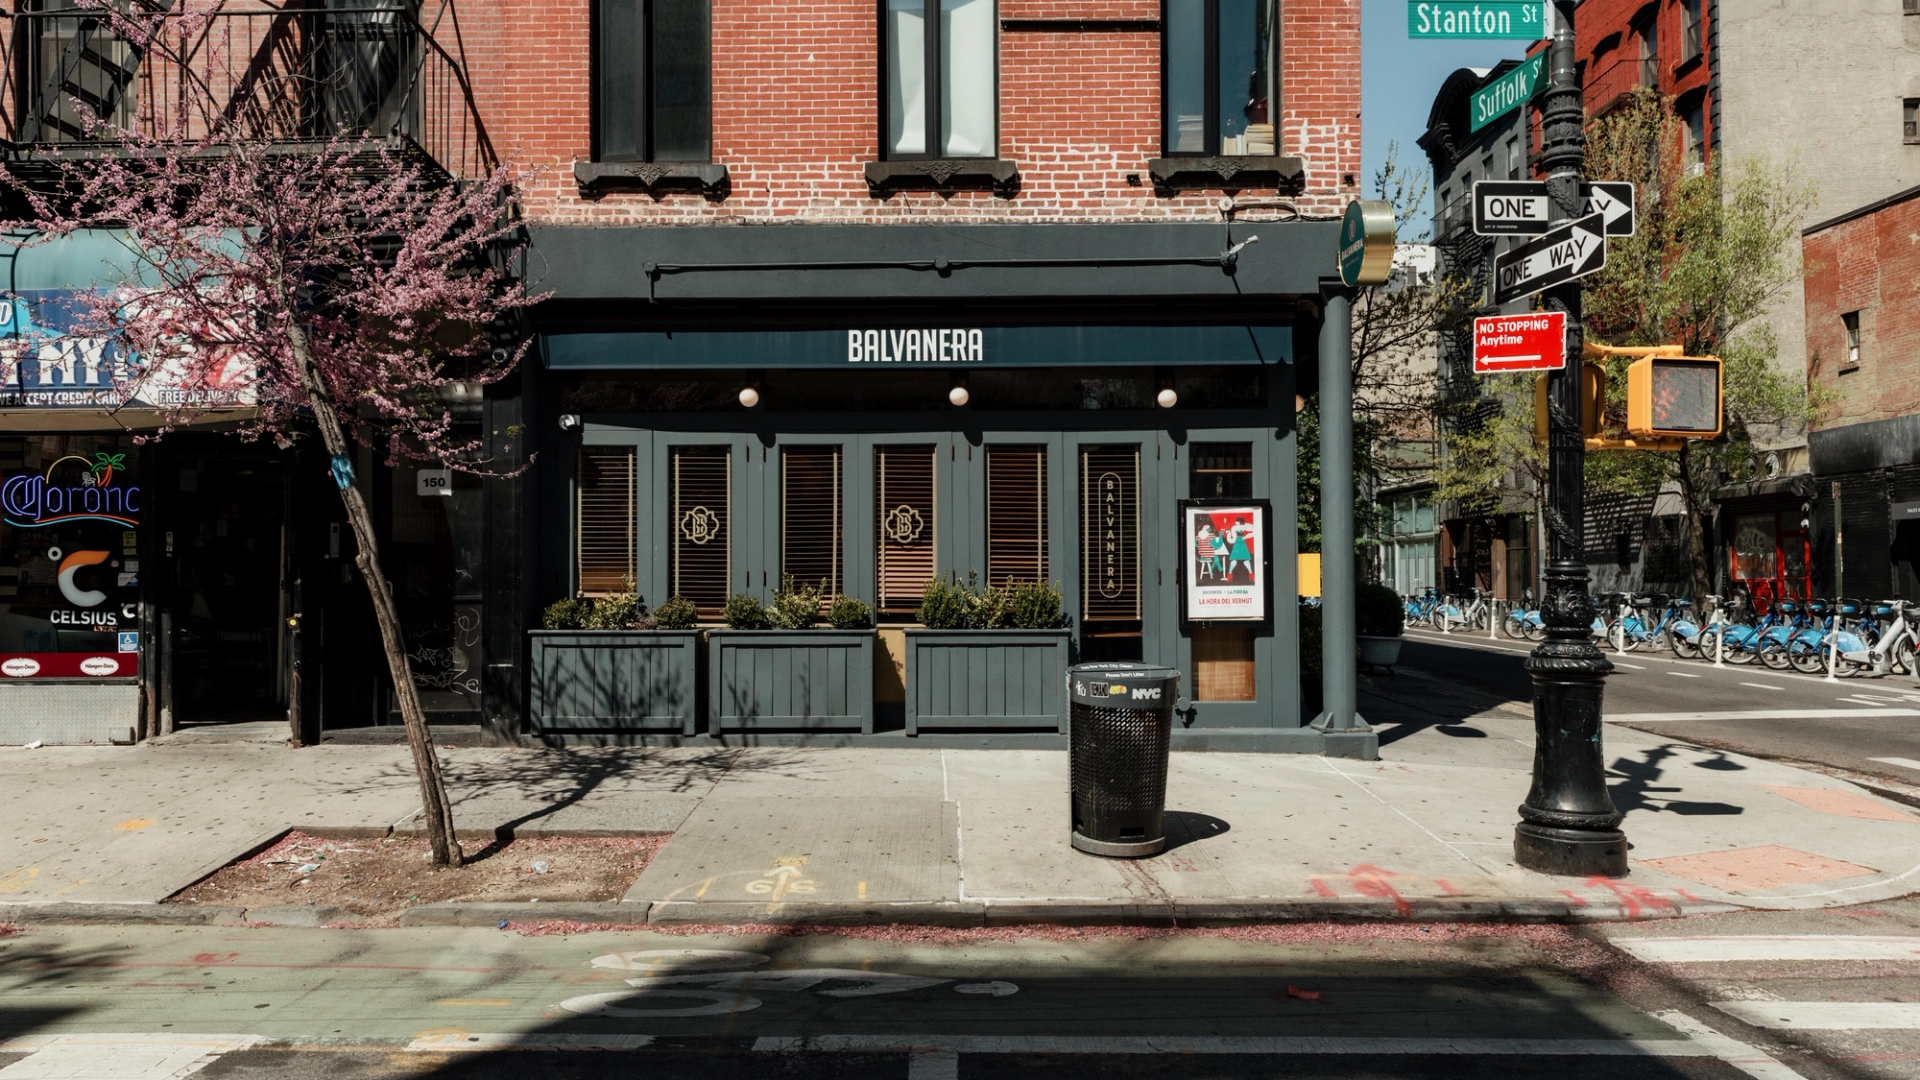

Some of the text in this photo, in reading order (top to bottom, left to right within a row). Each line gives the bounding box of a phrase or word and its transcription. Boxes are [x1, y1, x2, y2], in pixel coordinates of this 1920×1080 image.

[1417, 3, 1537, 33] Stanton St
[1478, 57, 1543, 122] Suffolk St
[1489, 198, 1536, 218] ONE
[1341, 238, 1364, 261] BALVANERA
[1503, 235, 1588, 287] ONE WAY
[1480, 319, 1549, 334] NO STOPPING
[848, 329, 983, 362] BALVANERA
[1480, 334, 1523, 348] Anytime
[14, 392, 53, 405] ACCEPT
[54, 392, 93, 405] CREDIT
[158, 390, 185, 404] FREE
[423, 478, 446, 488] 150
[1106, 480, 1115, 589] BALVANERA
[50, 610, 117, 626] CELSIUS
[1132, 688, 1161, 700] NYC
